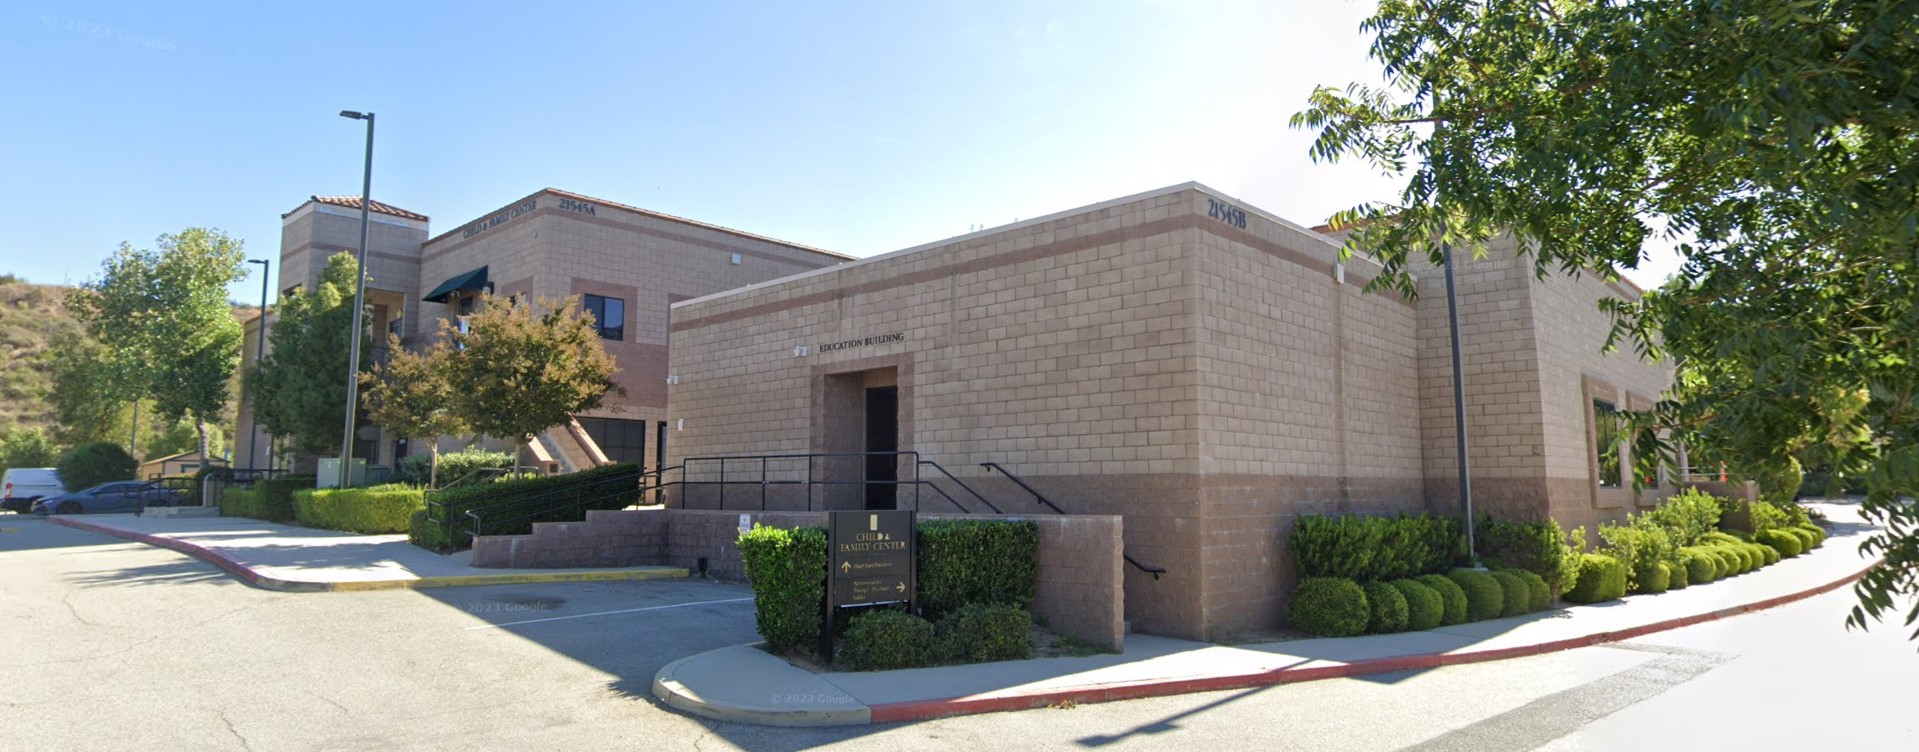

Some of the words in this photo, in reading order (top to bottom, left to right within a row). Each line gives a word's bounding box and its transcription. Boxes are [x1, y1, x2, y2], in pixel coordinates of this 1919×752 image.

[559, 198, 596, 216] 21545A
[1208, 198, 1246, 229] 21545B
[463, 223, 481, 239] CHILD
[489, 212, 510, 228] FAMILY
[511, 201, 537, 218] CENTER
[819, 338, 863, 353] EDUCATION
[864, 332, 904, 347] BUILDING
[856, 532, 883, 542] CHILD
[840, 543, 870, 553] FAMILY
[872, 541, 906, 551] CENTER
